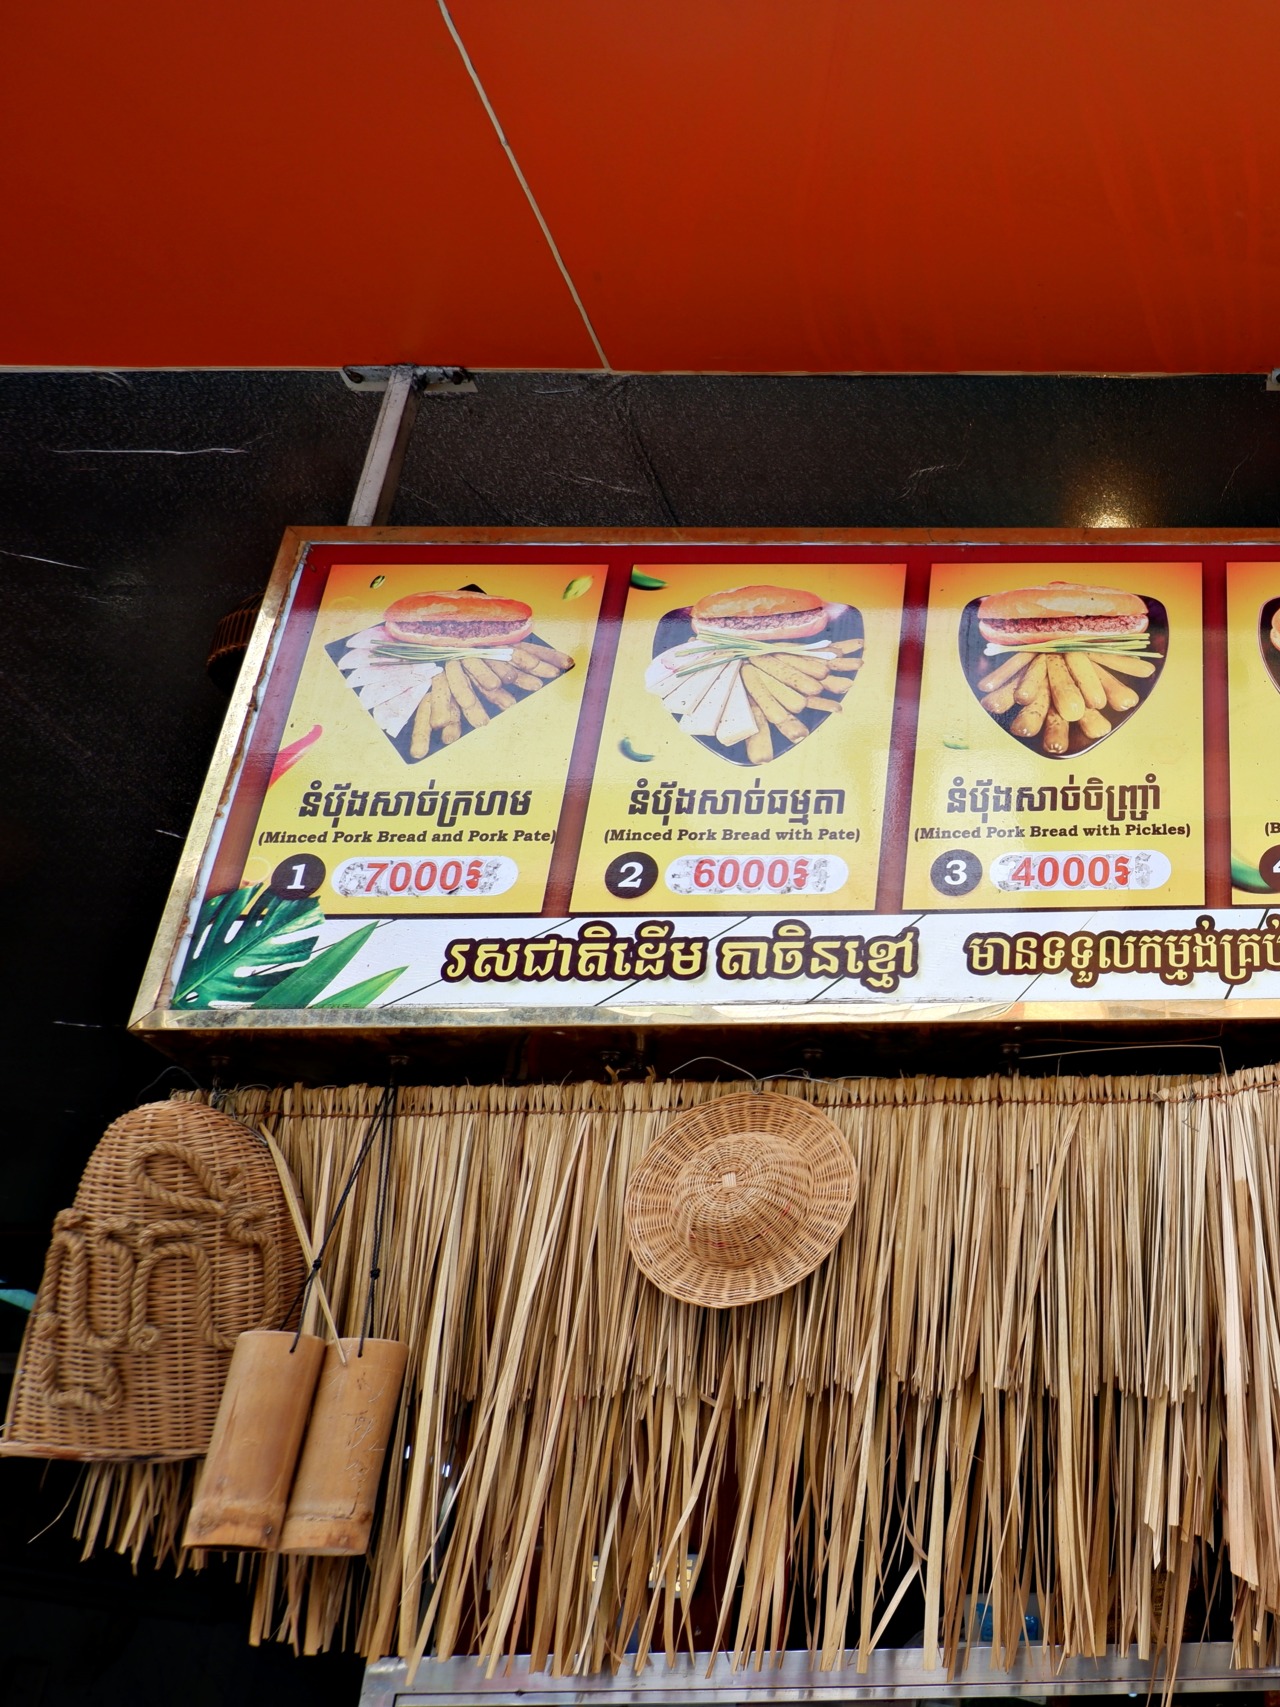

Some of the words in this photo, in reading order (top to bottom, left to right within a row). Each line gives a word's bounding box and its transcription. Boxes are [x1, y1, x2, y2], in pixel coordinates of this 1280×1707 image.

[258, 830, 327, 846] (Minced
[332, 831, 373, 843] Pork
[377, 831, 427, 843] Bread
[431, 831, 464, 843] and
[468, 830, 508, 842] Pork
[513, 830, 556, 844] Pate)
[604, 829, 672, 844] (Minced
[677, 829, 717, 841] Pork
[722, 829, 770, 841] Bread
[776, 829, 813, 841] with
[818, 828, 860, 843] Pate)
[914, 827, 981, 842] (Minced
[986, 826, 1025, 838] Pork
[1030, 825, 1078, 837] Bread
[1083, 825, 1121, 837] with
[1125, 823, 1191, 838] Pickles)
[287, 863, 306, 890] 1
[618, 861, 644, 889] 2
[944, 859, 968, 886] 3
[445, 923, 705, 979] រសជាតិដើម
